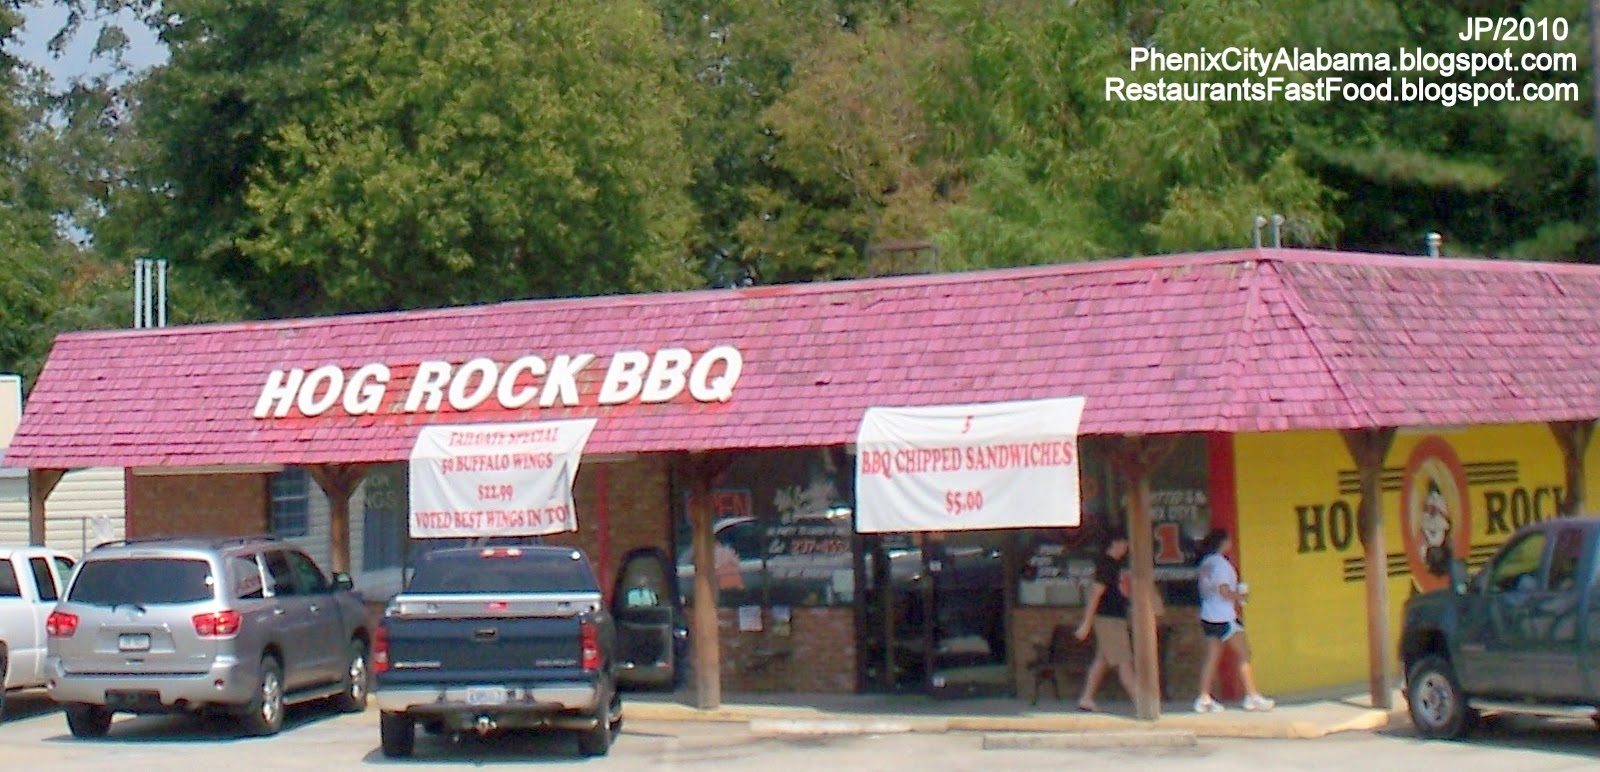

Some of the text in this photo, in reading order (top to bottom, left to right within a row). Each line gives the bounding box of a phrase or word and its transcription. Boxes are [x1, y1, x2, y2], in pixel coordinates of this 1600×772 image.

[253, 345, 744, 419] HOG ROCK BBQ
[961, 414, 975, 434] 5
[456, 453, 510, 473] BUFFALO
[512, 451, 554, 471] WINGS
[861, 440, 1073, 479] BBQ CHIPPED SANDWICHES
[945, 489, 983, 515] $5.00
[415, 511, 451, 529] VOTED
[454, 510, 483, 529] BEST
[486, 509, 524, 528] WINGS
[527, 508, 542, 527] IN
[1295, 500, 1367, 554] HO
